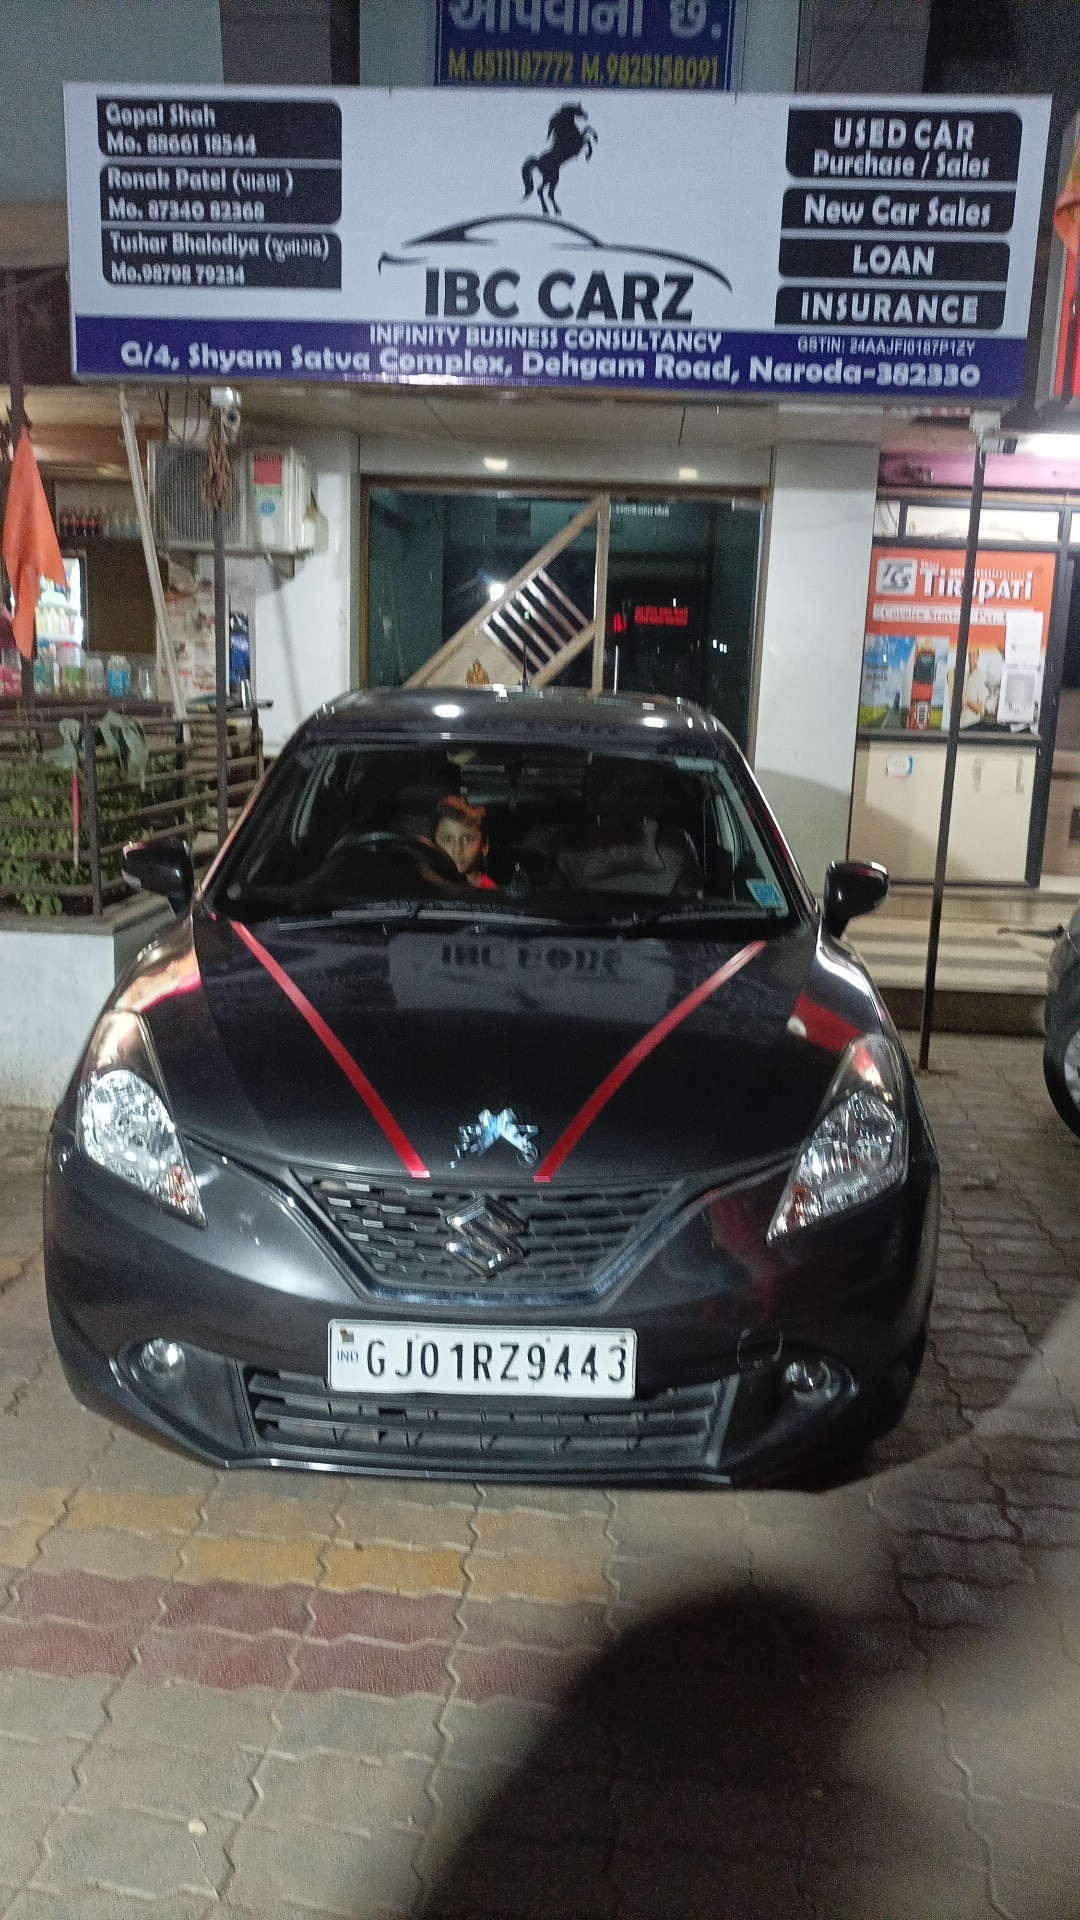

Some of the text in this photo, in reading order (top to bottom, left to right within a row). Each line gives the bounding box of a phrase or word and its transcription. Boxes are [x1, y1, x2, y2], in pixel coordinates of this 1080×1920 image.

[582, 51, 718, 87] M.9825158091
[106, 102, 216, 130] Gopal Shah
[107, 130, 142, 154] Mo.
[833, 117, 974, 150] USED CAR
[813, 149, 990, 179] Purchase / Sales
[108, 167, 170, 191] Ronak
[176, 167, 226, 192] Patel
[109, 196, 143, 220] Mo.
[804, 193, 991, 227] New Car Sales
[110, 230, 167, 254] Tushar
[172, 232, 259, 259] Bhalodiya
[852, 244, 935, 275] LOAN
[424, 267, 693, 323] IBC CARZ
[801, 291, 979, 324] INSURANCE
[370, 324, 722, 353] INFINITY BUSINESS CONSULTANCY
[189, 342, 282, 374] Shyam
[291, 344, 370, 371] Satva
[379, 347, 513, 378] Complex,
[522, 350, 645, 381] Dehgam
[654, 353, 740, 385] Road,
[750, 355, 980, 387] Naroda-382330
[337, 1350, 359, 1363] IND
[366, 1339, 626, 1383] GJ01RZ9443
